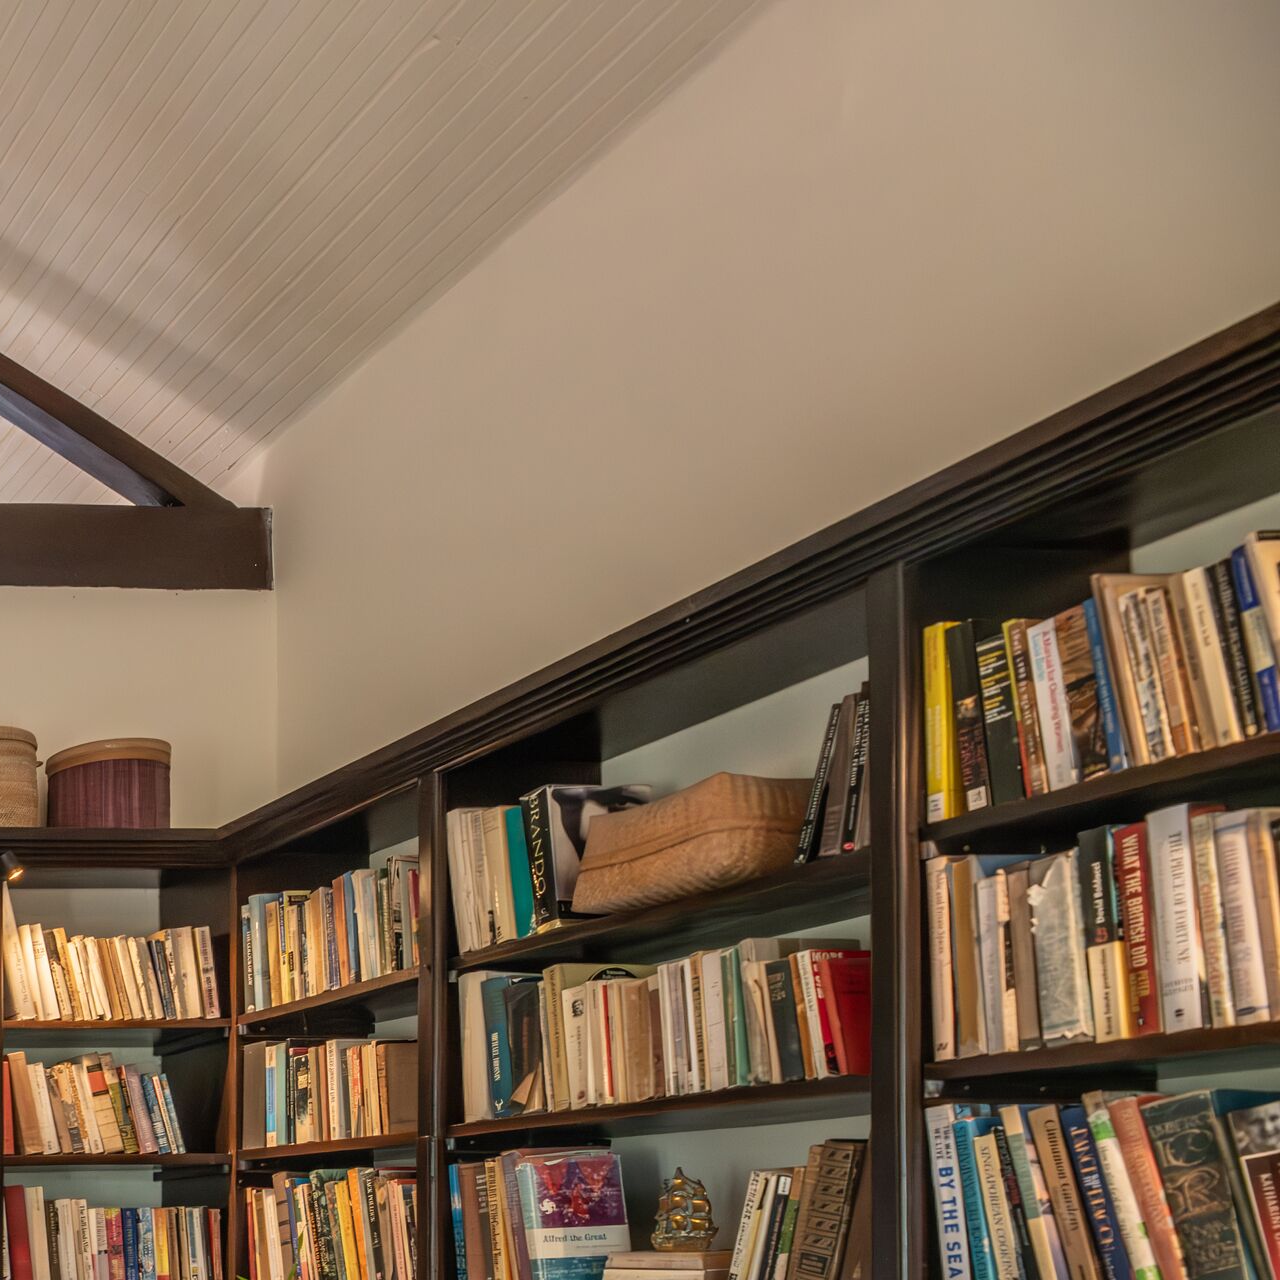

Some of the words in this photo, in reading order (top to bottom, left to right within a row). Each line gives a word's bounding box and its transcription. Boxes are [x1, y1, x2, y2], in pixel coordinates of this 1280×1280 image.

[529, 794, 547, 899] BRANDO
[1120, 834, 1142, 869] WHAT
[1167, 831, 1184, 855] THE
[1090, 862, 1106, 898] Baldacci
[1123, 870, 1143, 894] THE
[1168, 855, 1187, 891] PRICE
[1093, 899, 1106, 923] David
[1173, 892, 1186, 906] OF
[1125, 897, 1147, 943] BRITISH
[1171, 909, 1193, 964] FORTUNE
[1130, 946, 1147, 968] DID
[487, 1166, 497, 1198] BERNARD
[937, 1165, 956, 1191] BY
[1043, 1119, 1067, 1179] Cinnamon
[1060, 1180, 1081, 1232] Gardens
[490, 1199, 499, 1220] LEVIN
[939, 1196, 962, 1234] THE
[979, 1144, 1004, 1227] SINGAPOREAN
[996, 1227, 1016, 1280] COOKING
[543, 1234, 568, 1244] Alfred
[570, 1234, 581, 1243] the
[584, 1232, 607, 1242] Great
[943, 1240, 966, 1279] SEA
